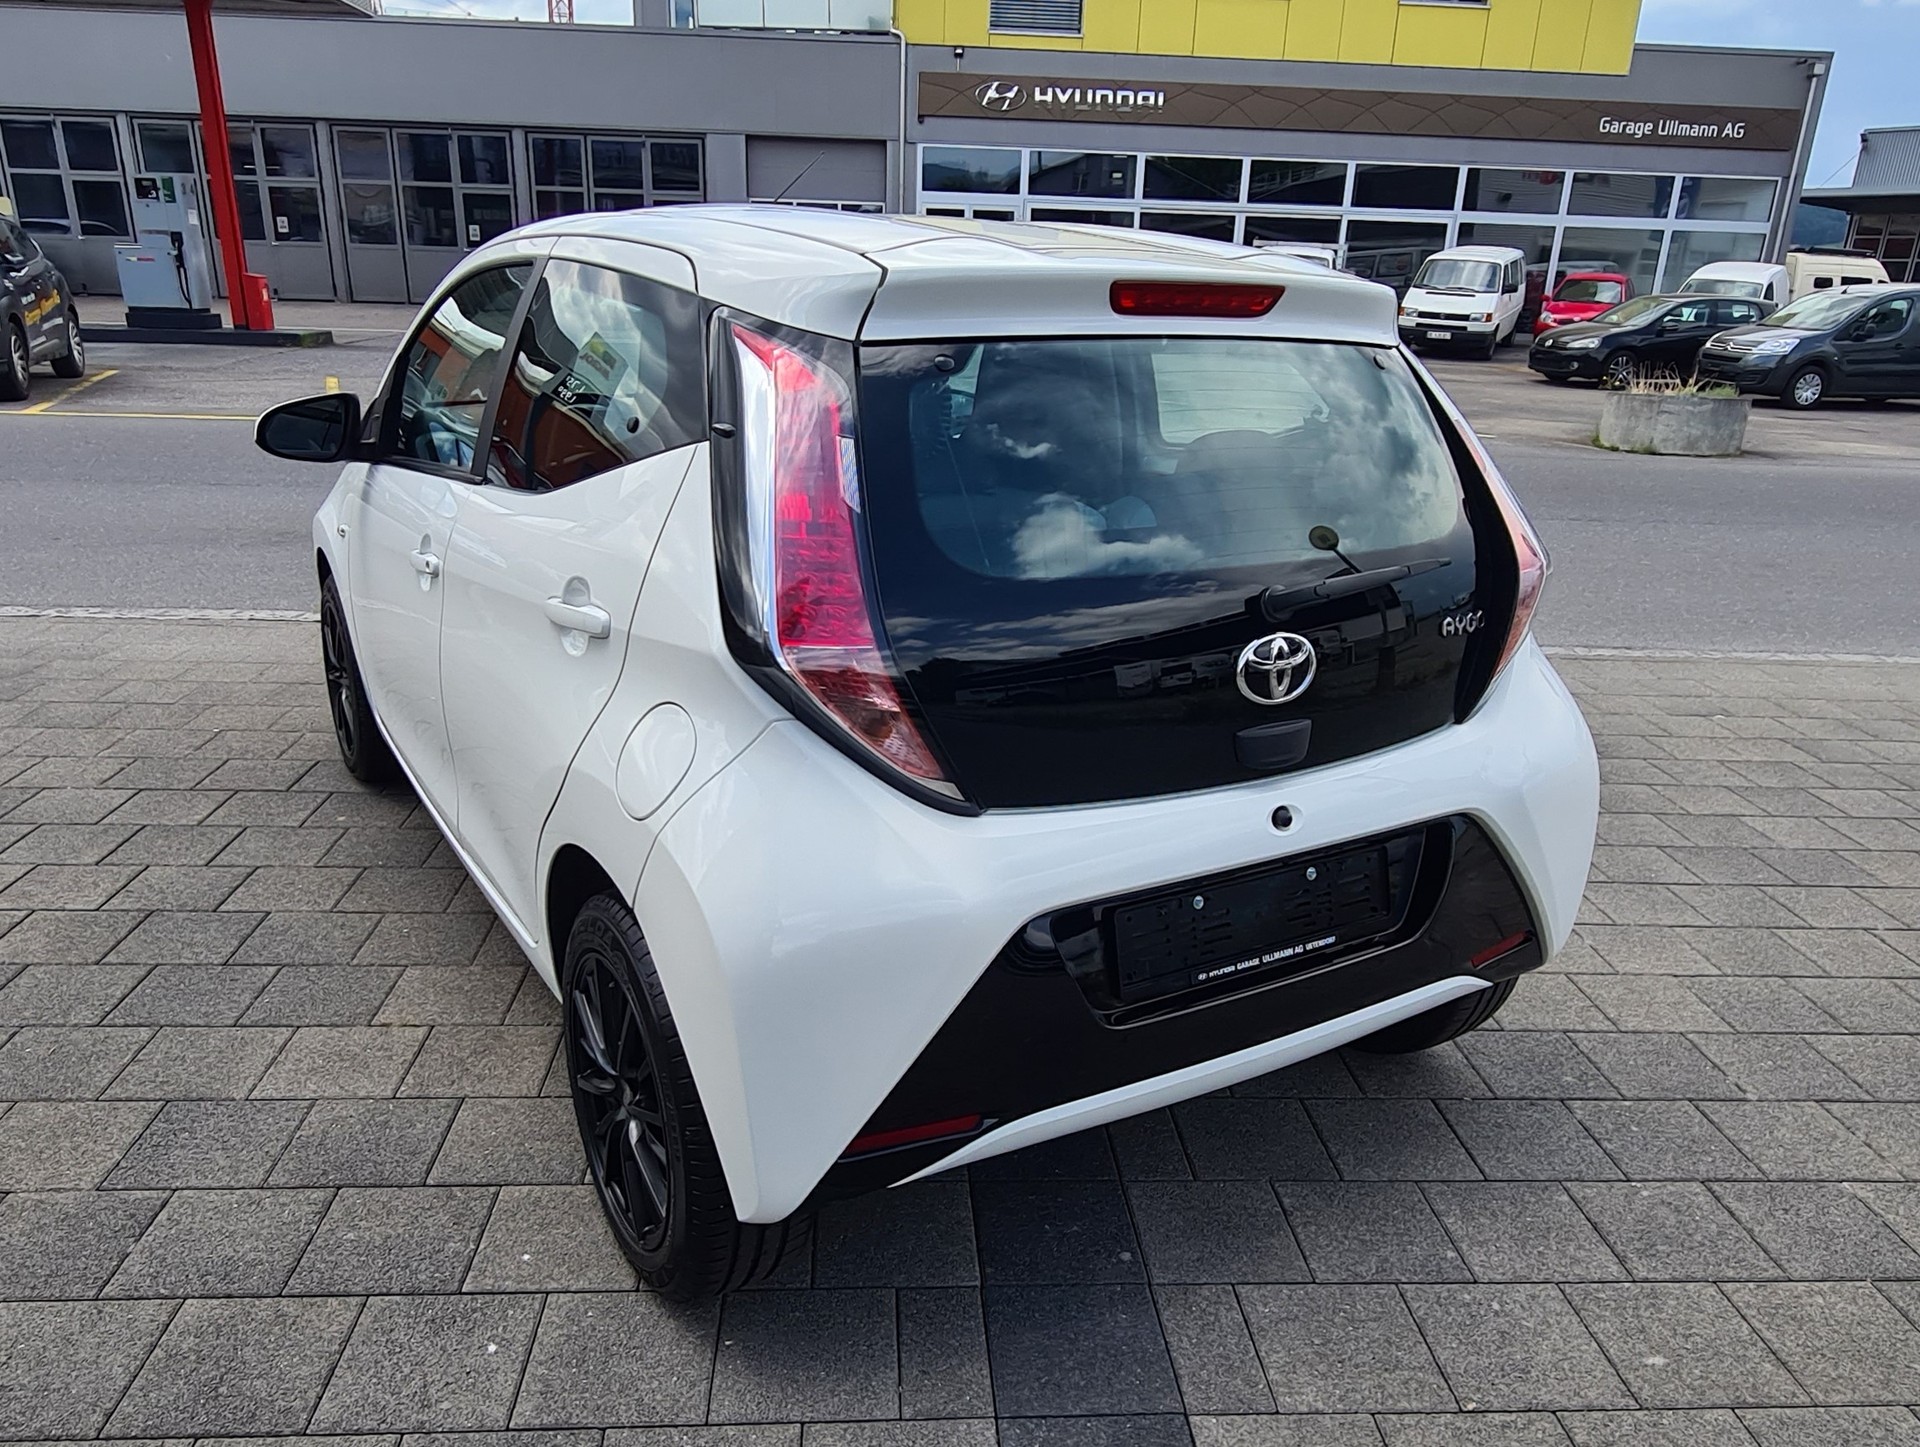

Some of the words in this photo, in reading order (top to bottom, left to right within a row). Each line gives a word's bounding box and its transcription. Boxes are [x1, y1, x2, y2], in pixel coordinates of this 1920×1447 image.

[1034, 86, 1165, 110] HYUNDAI
[1599, 117, 1654, 139] Garage
[1657, 119, 1718, 138] Ullmann
[1721, 122, 1746, 139] AG
[1441, 609, 1486, 637] AYGO
[1262, 947, 1294, 963] ULLMANN
[1294, 944, 1304, 955] AG
